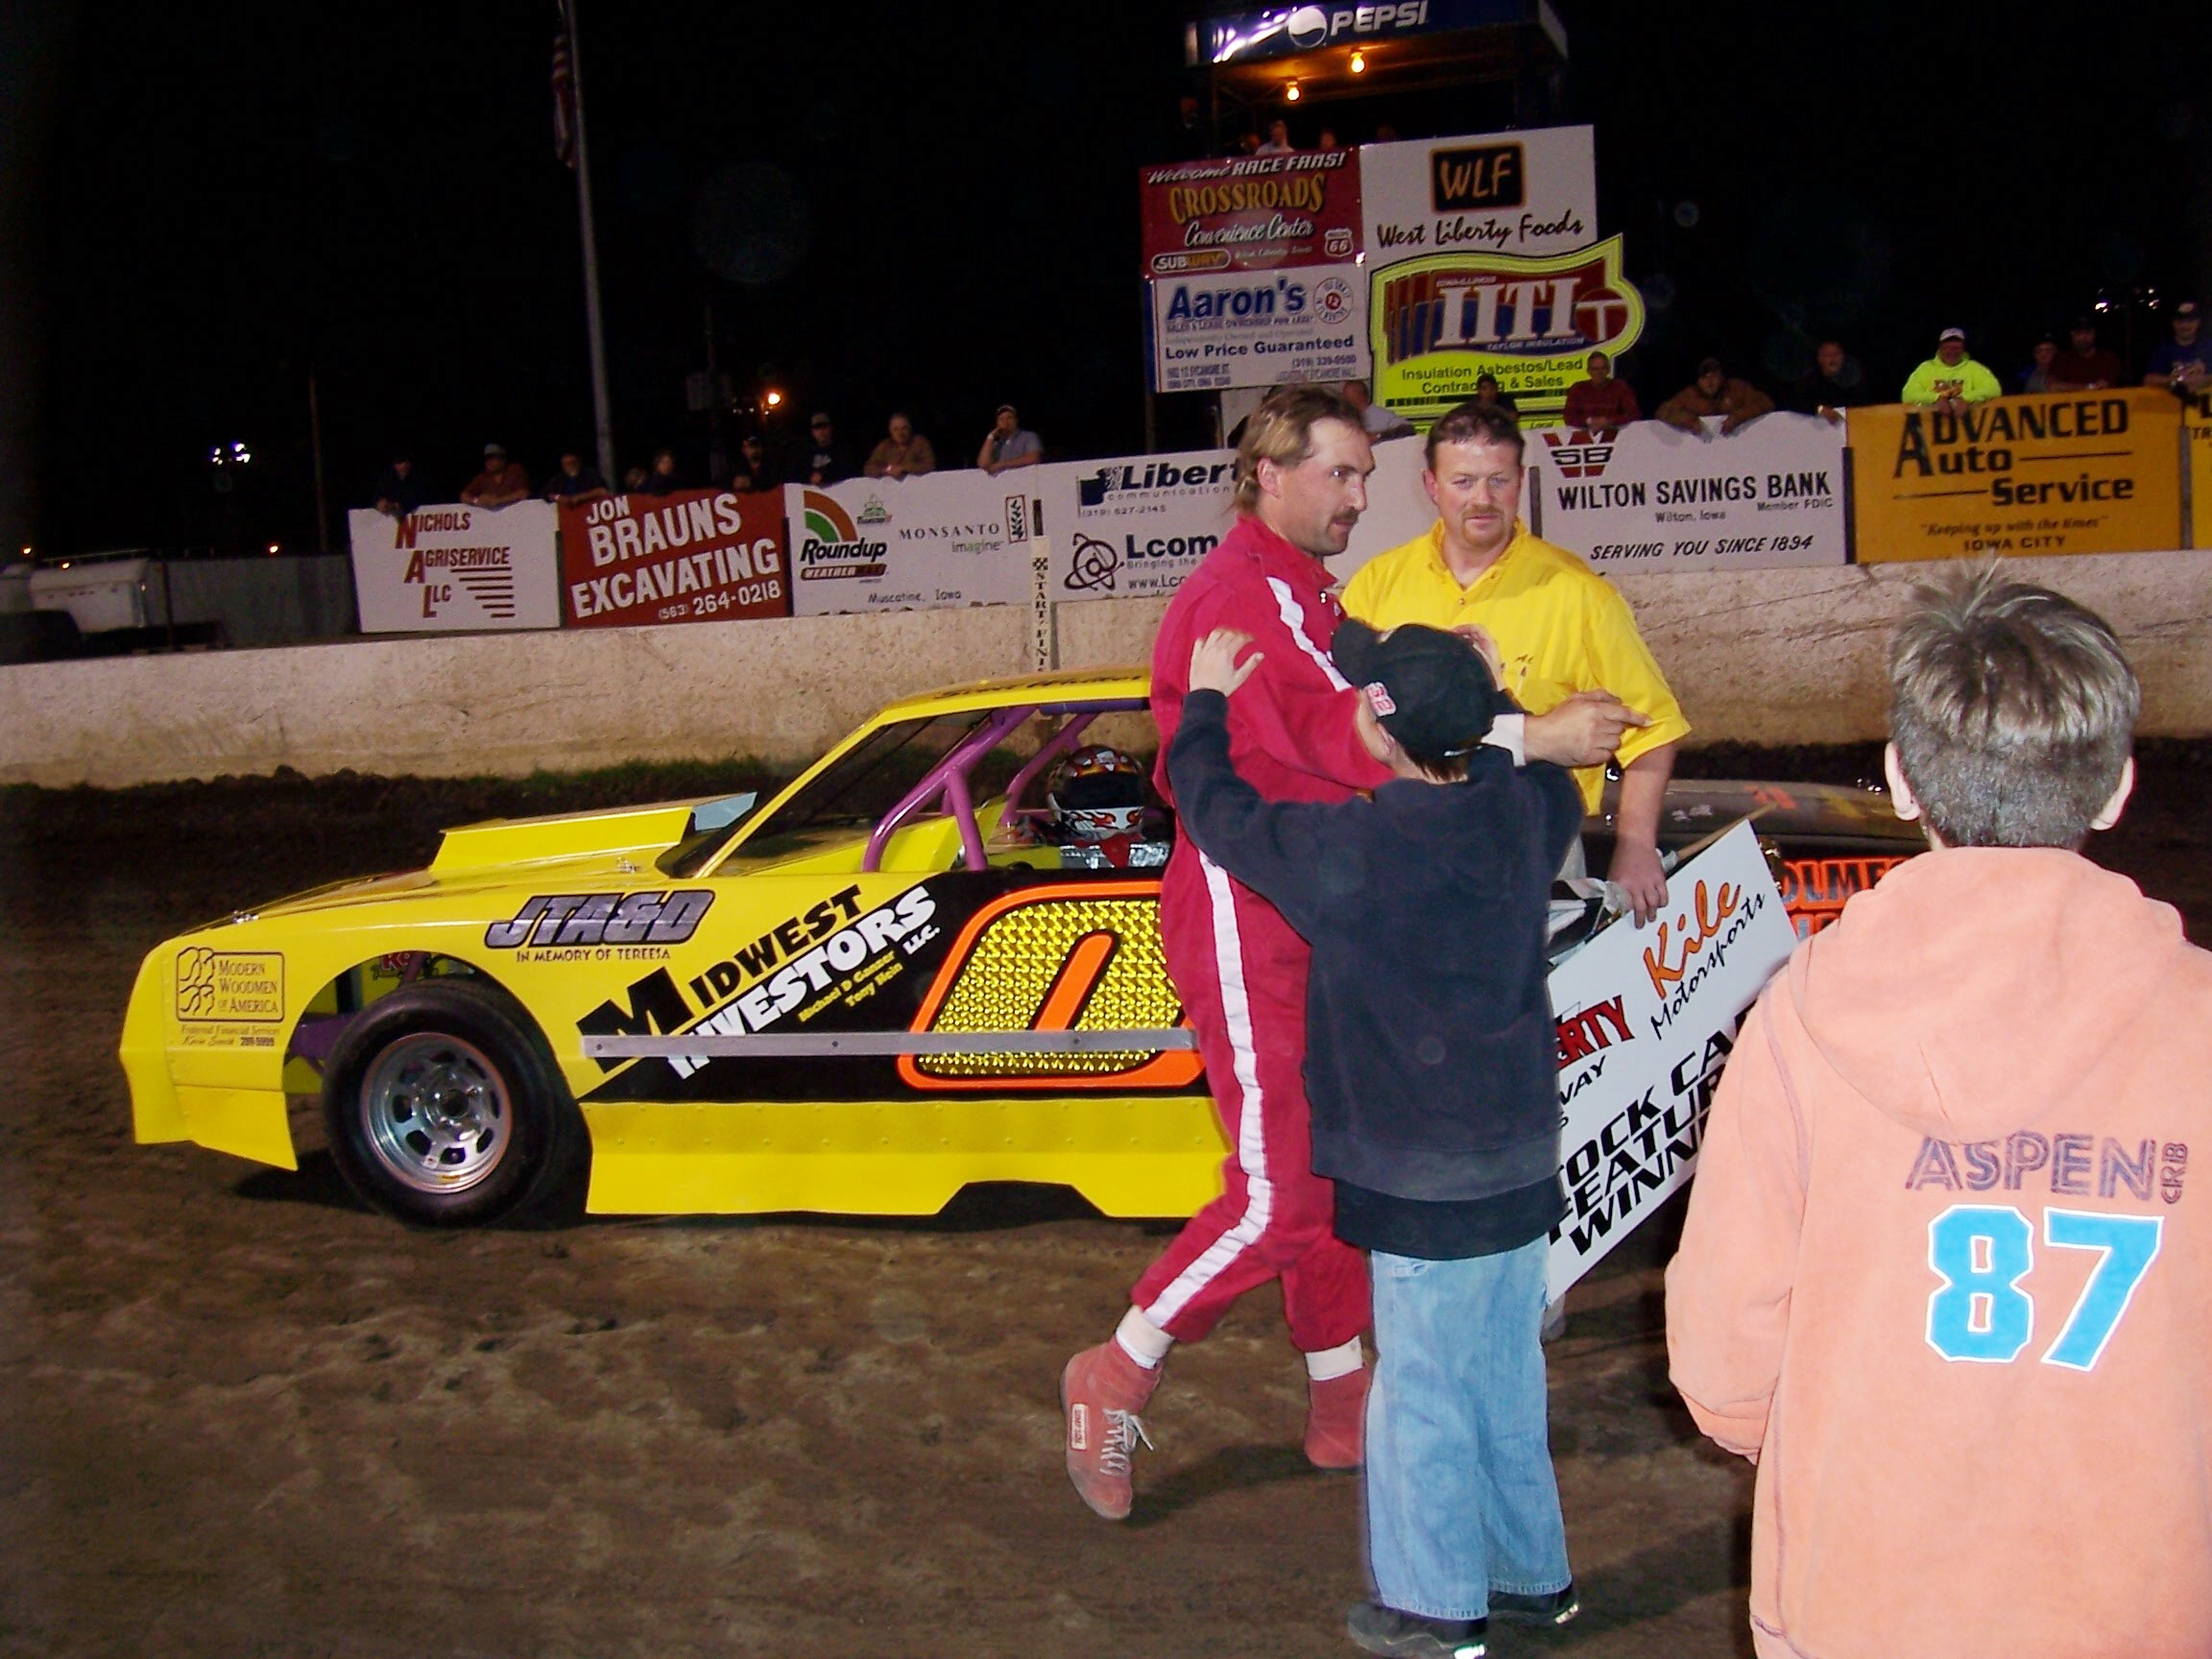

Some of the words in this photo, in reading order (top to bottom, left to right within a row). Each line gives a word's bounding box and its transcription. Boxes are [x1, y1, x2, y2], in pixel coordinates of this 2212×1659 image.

[1331, 0, 1428, 36] PEPSI
[1232, 156, 1284, 176] RACE
[1441, 153, 1513, 200] WLF
[1169, 173, 1326, 225] CROSSROADS
[1377, 223, 1426, 249] West
[1435, 216, 1513, 249] Liberty
[1520, 208, 1584, 243] Foods
[1166, 276, 1307, 321] Aaron's
[1166, 346, 1198, 360] Low
[1204, 342, 1248, 357] Price
[1254, 335, 1355, 354] Guaranteed
[1403, 361, 1472, 379] Insulation
[1477, 358, 1583, 376] Asbestos/Lead
[1510, 378, 1521, 390] &
[1525, 374, 1564, 388] Sales
[1893, 398, 2128, 477] ADVANCED
[1121, 459, 1240, 491] Libert
[1557, 482, 1647, 510] WILTON
[1656, 476, 1757, 506] SAVINGS
[1767, 471, 1832, 498] BANK
[1992, 472, 2134, 507] Service
[586, 495, 631, 525] JON
[1107, 486, 1230, 500] communication
[1757, 500, 1799, 513] Member
[396, 512, 470, 549] NICHOLS
[589, 493, 742, 566] BRAUNS
[899, 523, 1000, 540] MONSANTO
[1699, 510, 1726, 521] Iowa
[801, 538, 887, 565] Roundup
[1590, 542, 1665, 561] SERVING
[1673, 540, 1709, 556] YOU
[1715, 537, 1767, 554] SINCE
[1770, 535, 1815, 552] 1894
[1964, 538, 2012, 551] IOWA
[2020, 536, 2066, 549] CITY
[404, 547, 511, 584] AGRISERVICE
[571, 539, 781, 618] EXCAVATING
[422, 585, 451, 618] LLC
[693, 580, 781, 615] 264-0218
[935, 589, 962, 601] Iowa
[517, 950, 528, 962] IN
[534, 949, 590, 962] MEMORY
[596, 949, 610, 960] OF
[1643, 879, 1741, 1000] Kile
[576, 884, 862, 1073] MIDWEST
[1650, 892, 1766, 1040] Motorsports
[1905, 1130, 2157, 1201] ASPEN
[1925, 1204, 2165, 1372] 87
